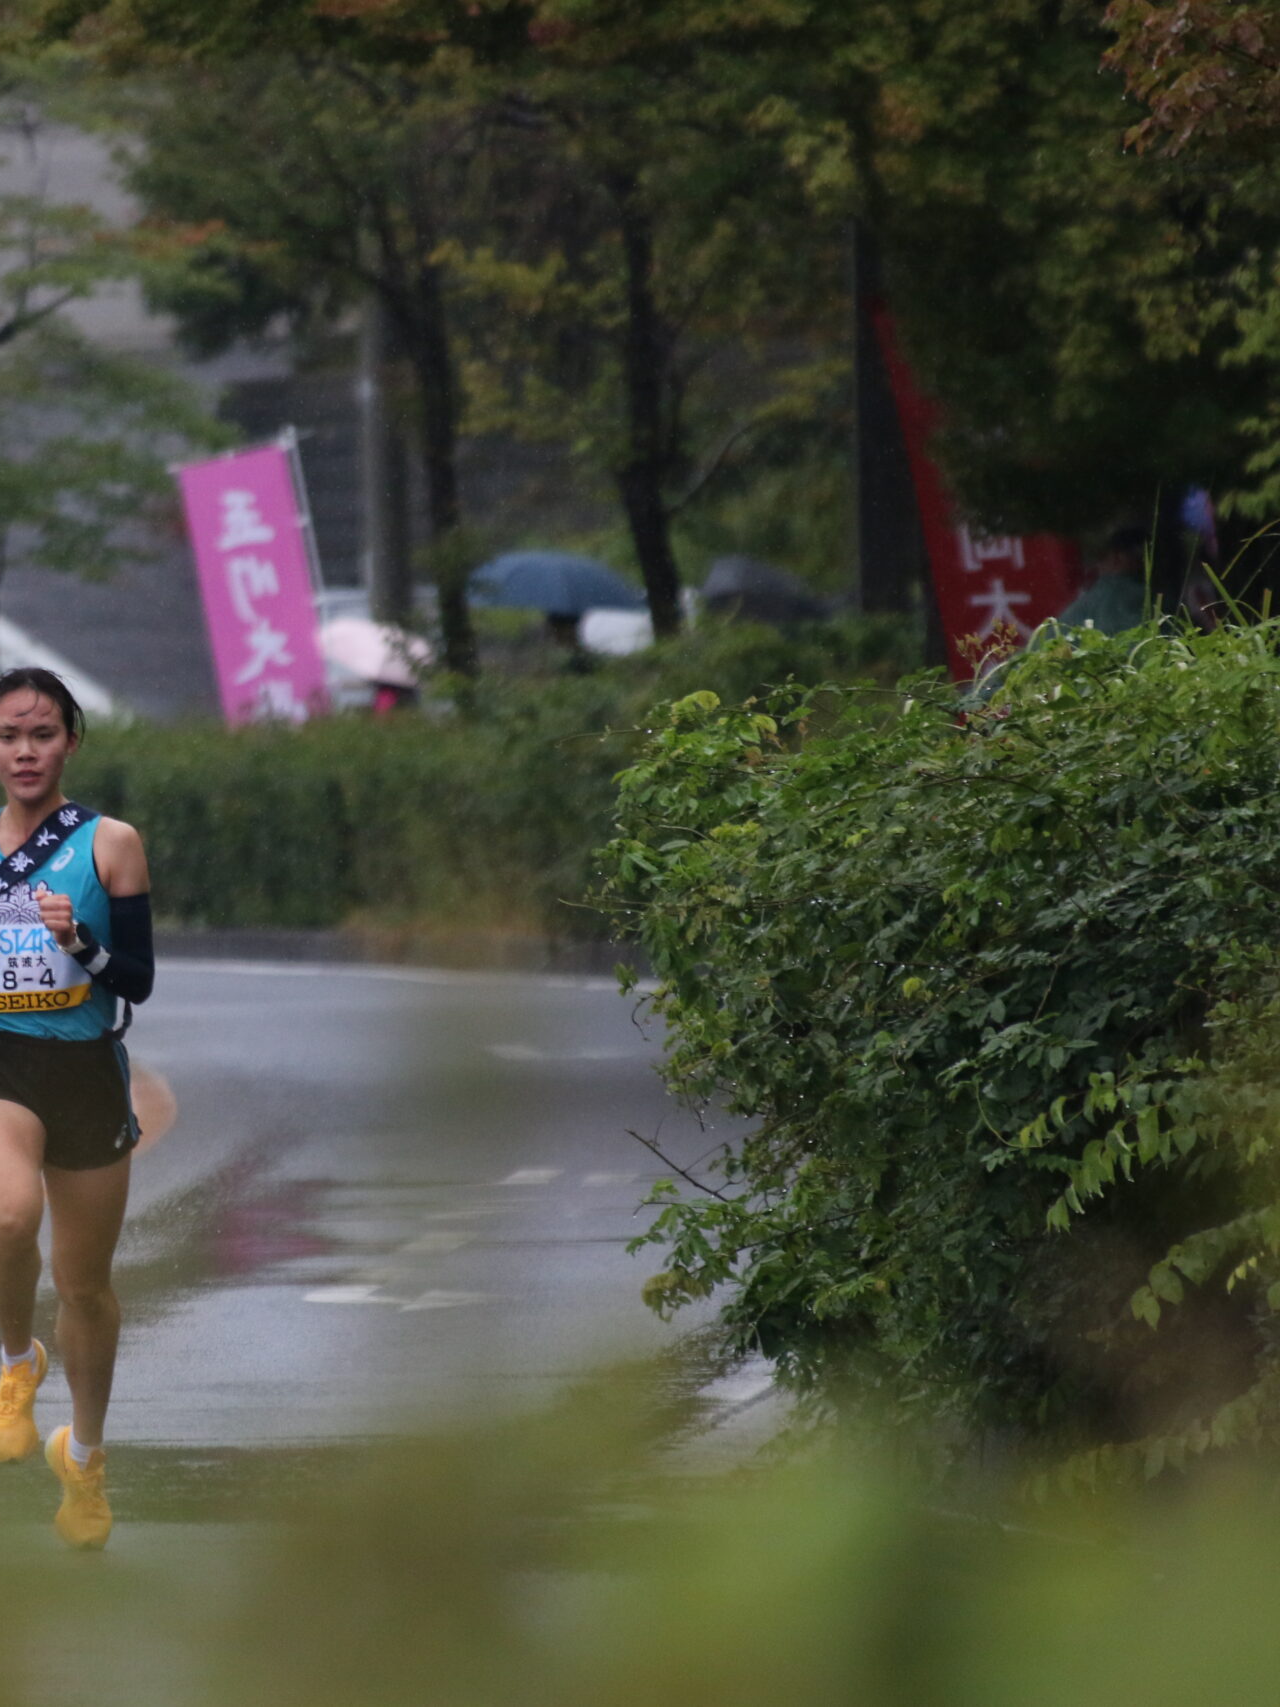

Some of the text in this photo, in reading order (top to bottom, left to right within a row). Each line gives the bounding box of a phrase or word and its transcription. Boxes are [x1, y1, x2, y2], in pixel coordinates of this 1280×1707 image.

[0, 929, 59, 955] STAR
[8, 955, 47, 968] 筑波大
[2, 968, 56, 990] 8-4
